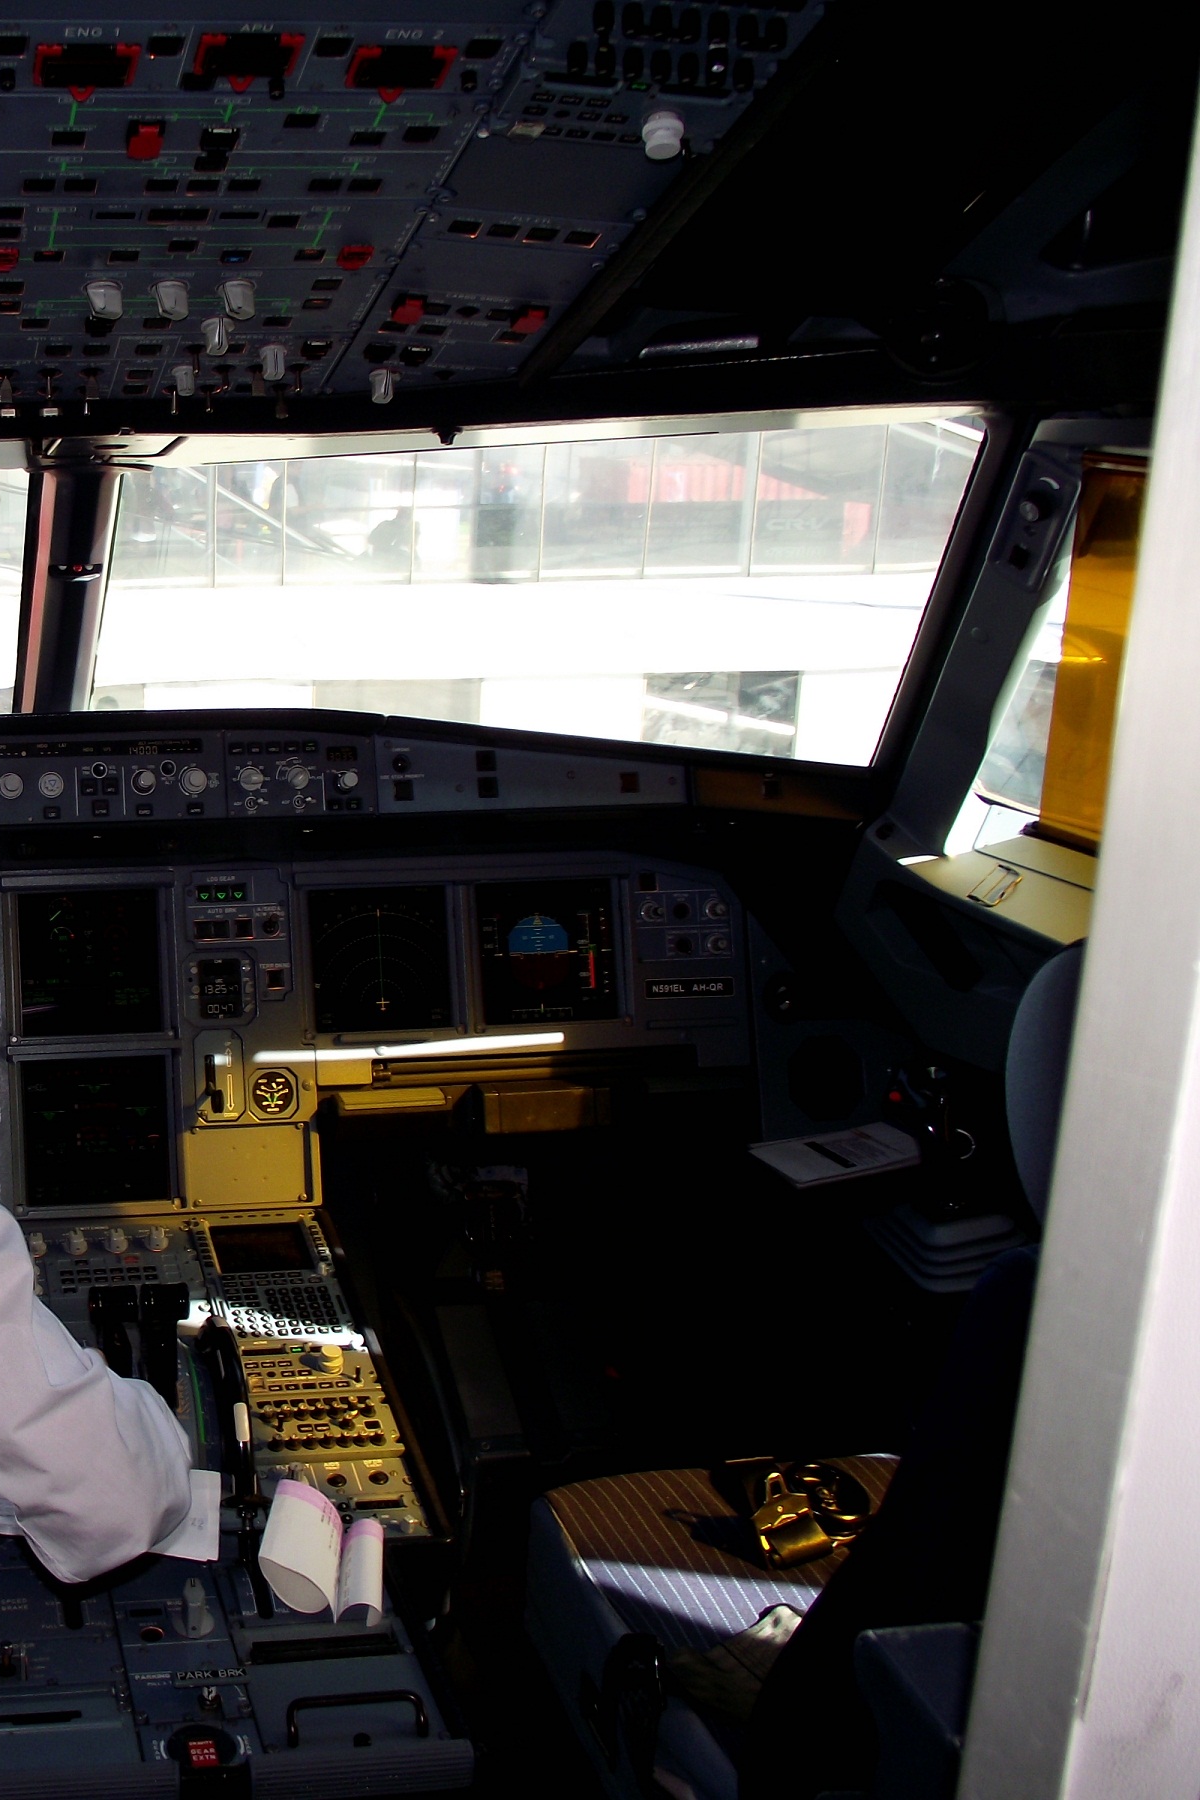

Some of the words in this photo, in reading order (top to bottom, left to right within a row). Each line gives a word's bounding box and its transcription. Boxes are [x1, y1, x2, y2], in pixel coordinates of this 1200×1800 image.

[65, 27, 103, 38] ENG
[115, 27, 120, 37] 1
[239, 23, 275, 33] APU
[385, 29, 424, 40] ENG
[433, 30, 444, 40] 2
[435, 318, 488, 327] VENTILATION
[128, 746, 158, 755] 14000
[652, 984, 685, 993] N591EL
[692, 982, 724, 991] AH-QR
[177, 1670, 213, 1680] PARK
[218, 1668, 244, 1677] BRK
